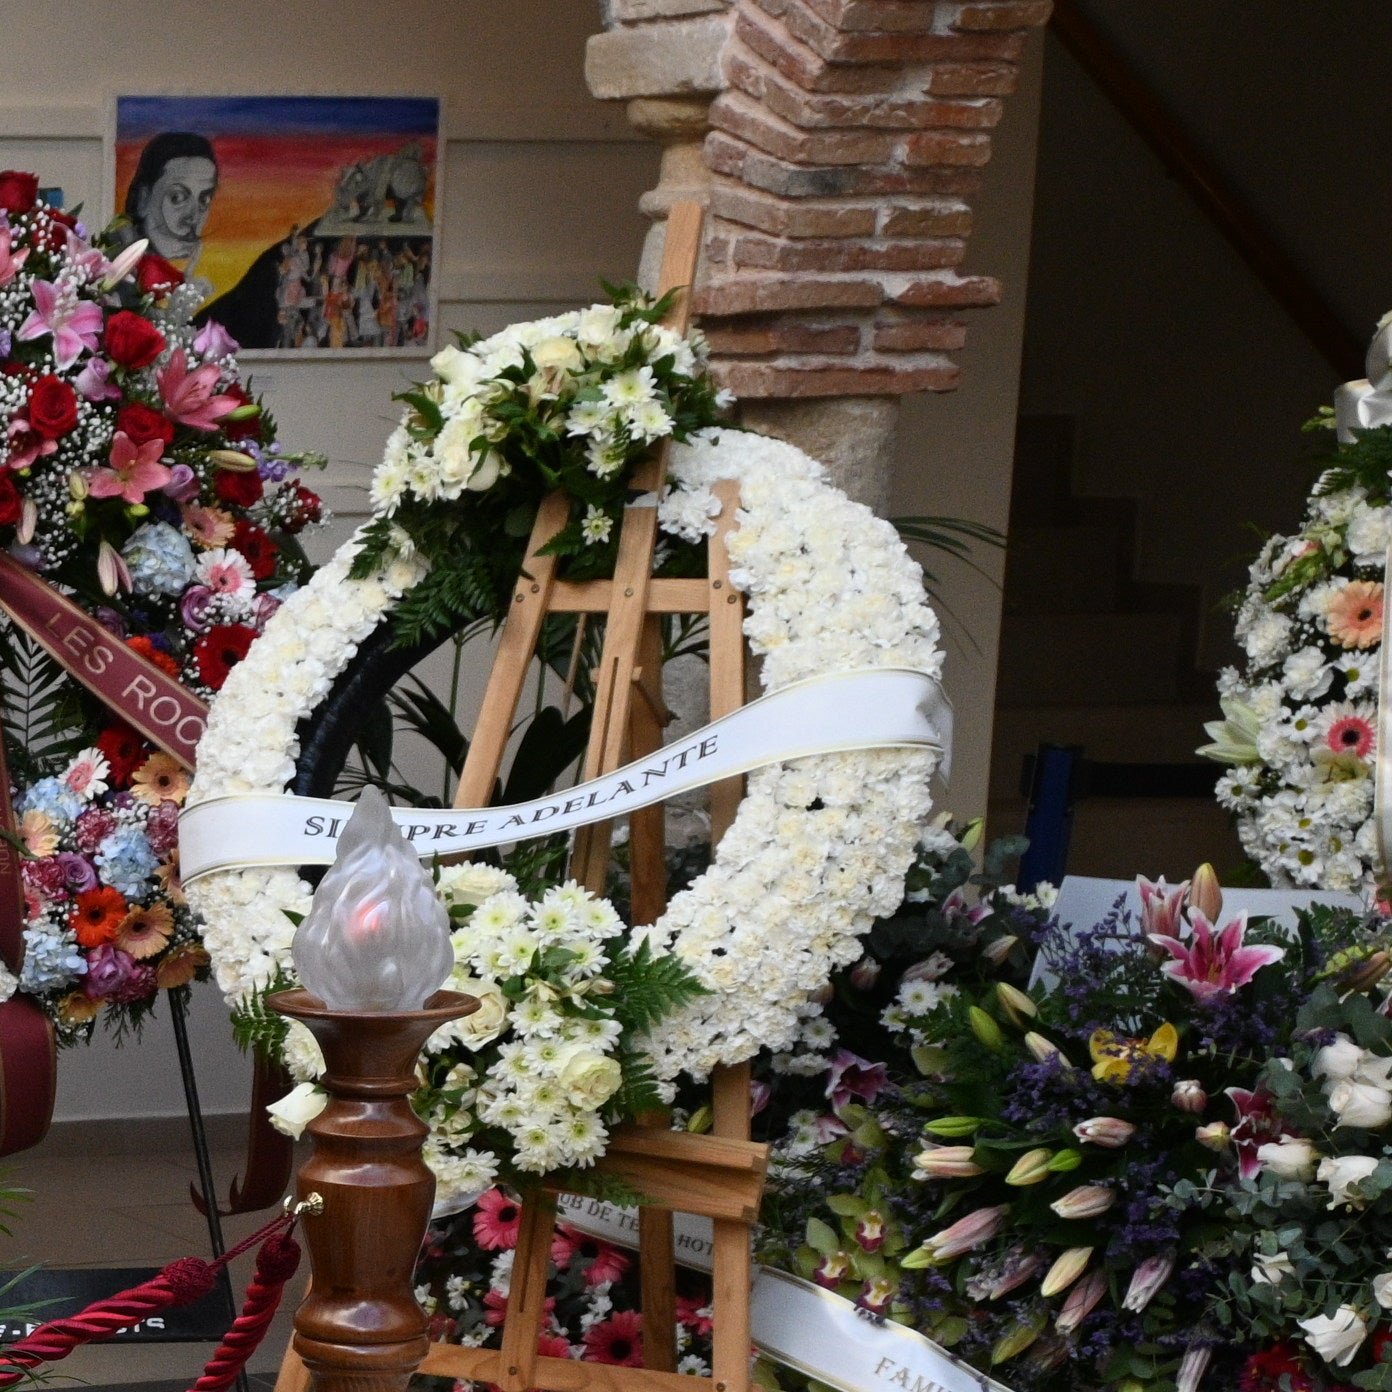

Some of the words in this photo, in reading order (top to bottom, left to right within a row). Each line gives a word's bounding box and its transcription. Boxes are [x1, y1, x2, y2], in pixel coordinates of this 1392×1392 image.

[44, 611, 114, 675] LES
[120, 673, 209, 746] ROC
[304, 815, 489, 842] SIPRE
[497, 734, 719, 830] ADELANTE
[559, 1193, 583, 1210] UB
[586, 1201, 613, 1222] DE
[618, 1212, 640, 1232] TE
[677, 1233, 714, 1256] HOT
